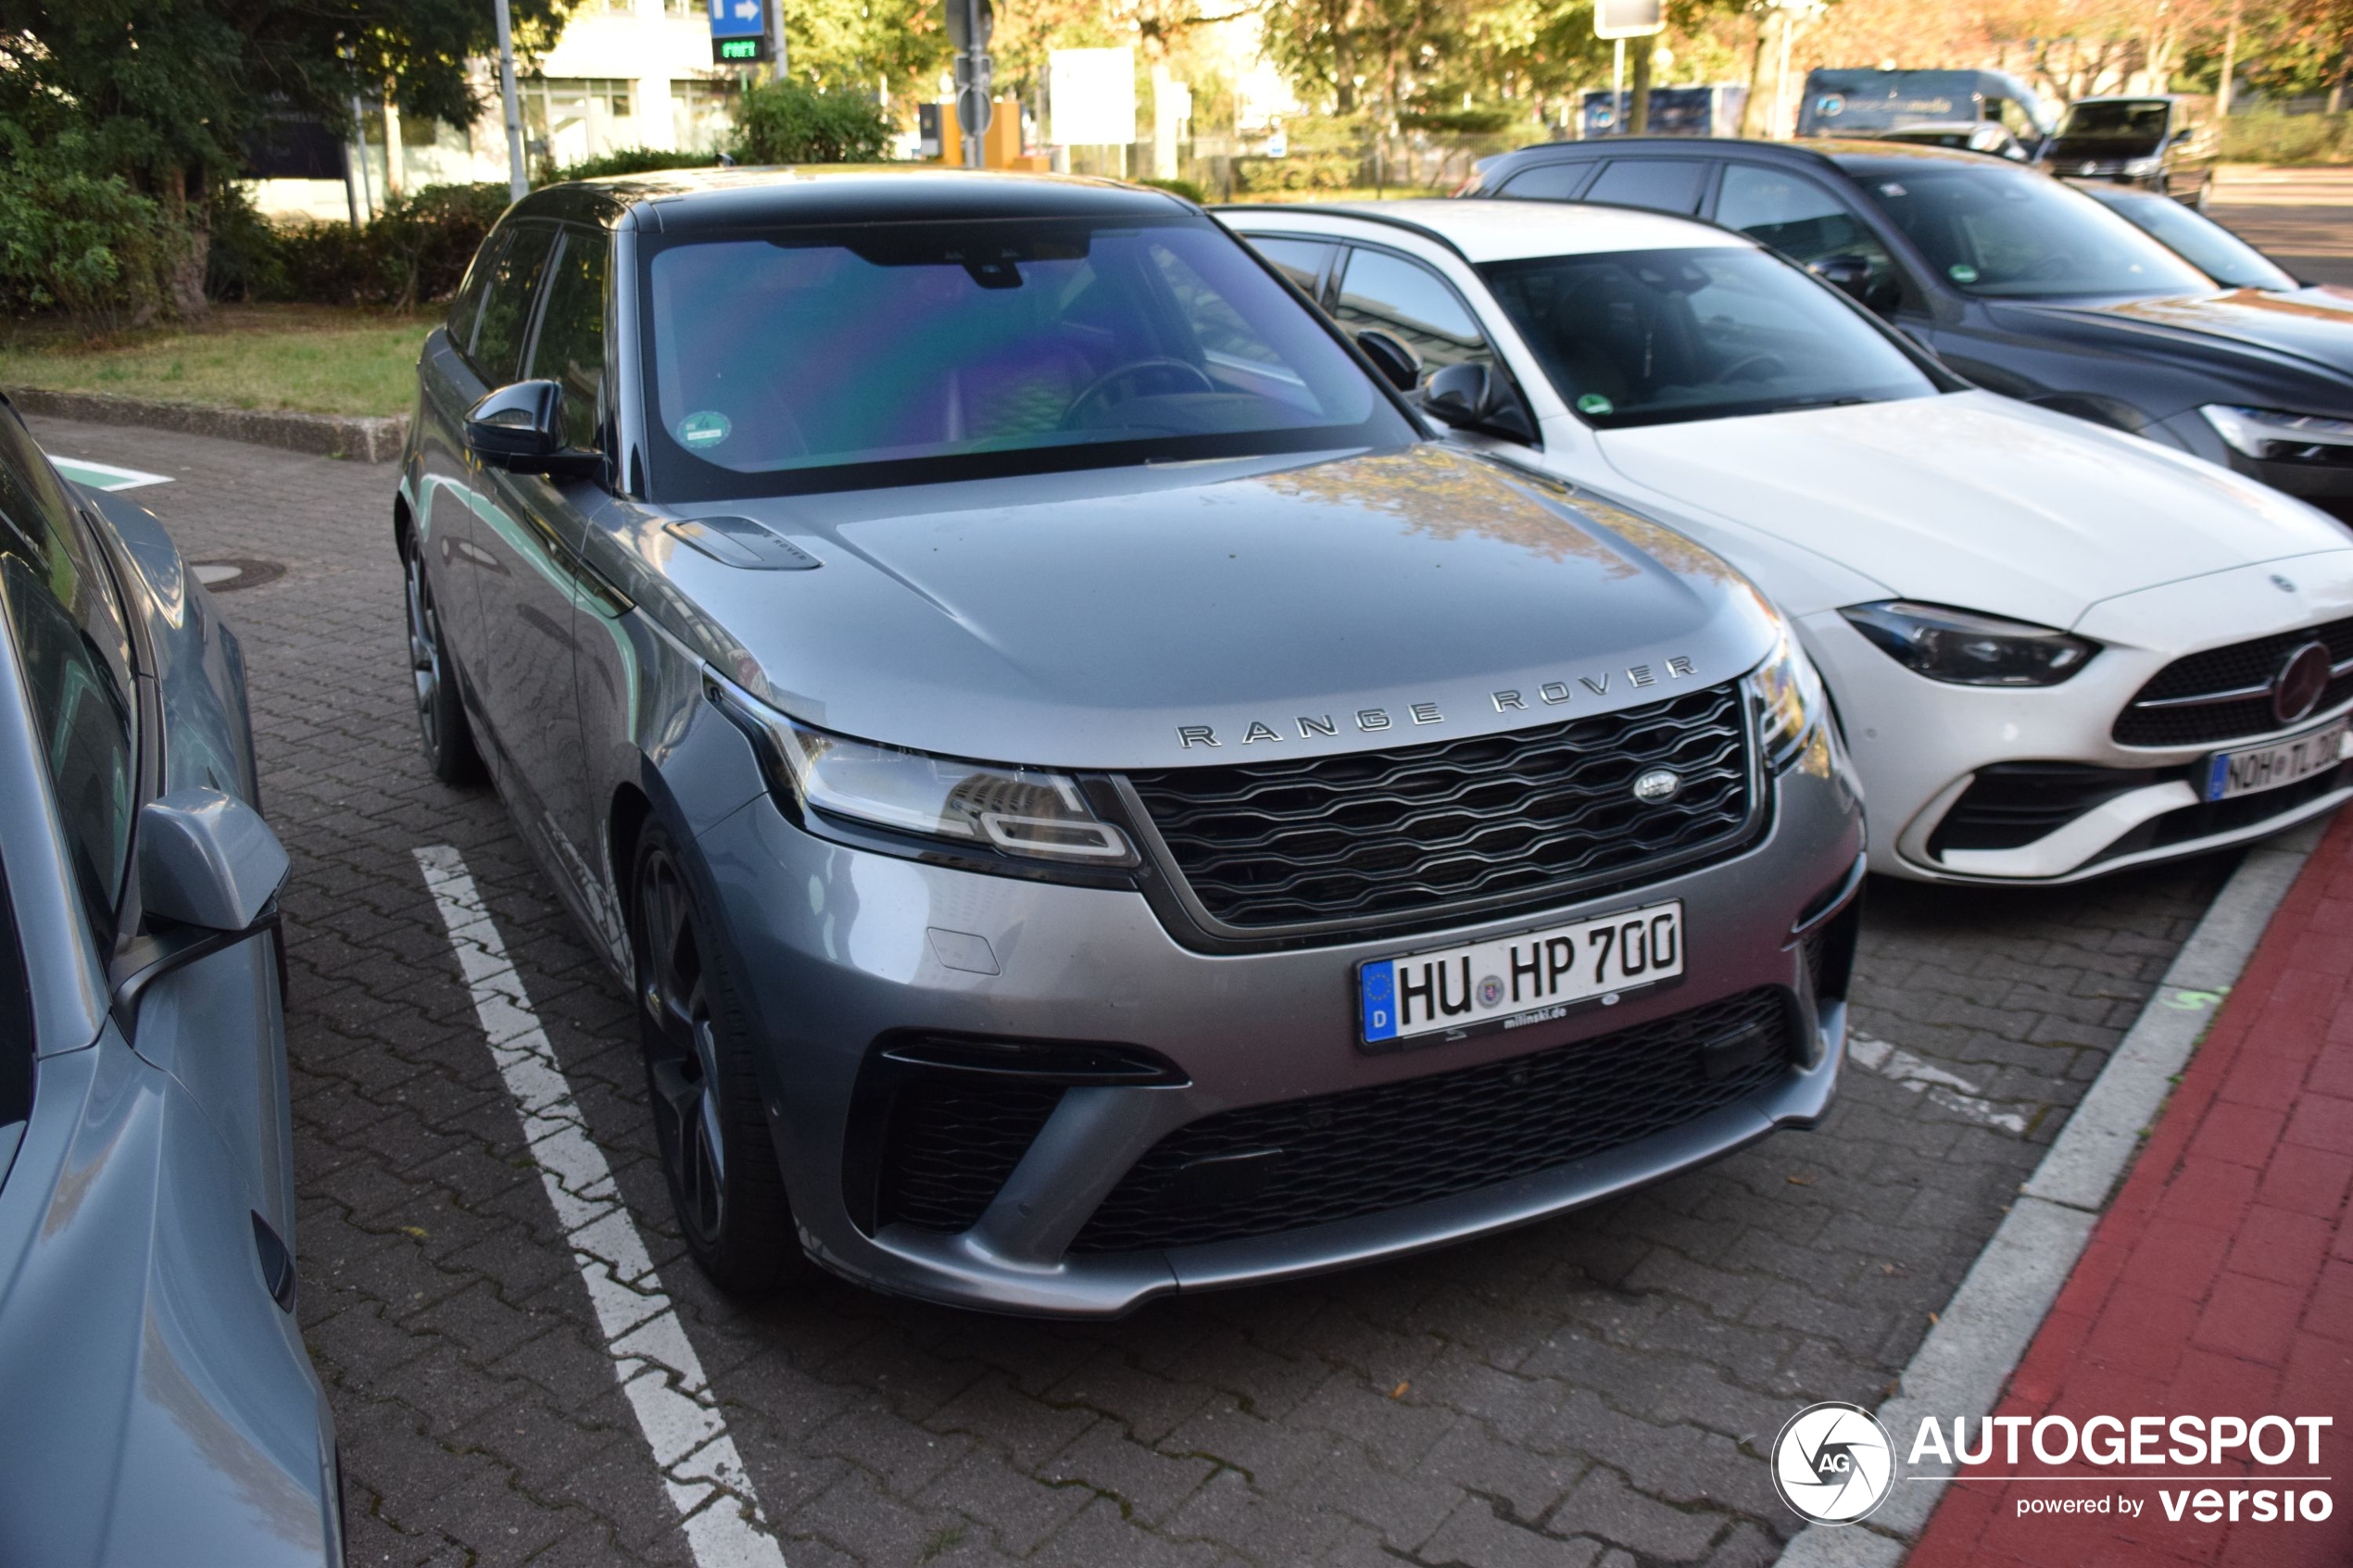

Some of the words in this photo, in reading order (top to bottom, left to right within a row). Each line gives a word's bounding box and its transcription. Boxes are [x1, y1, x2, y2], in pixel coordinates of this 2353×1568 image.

[1176, 702, 1444, 749] RANGE
[1491, 656, 1699, 714] ROVER
[1400, 956, 1471, 1025] HU
[1510, 937, 1575, 1002] HP
[1589, 913, 1675, 984] 700
[1374, 1010, 1387, 1028] D
[1504, 1008, 1567, 1030] milinski.de
